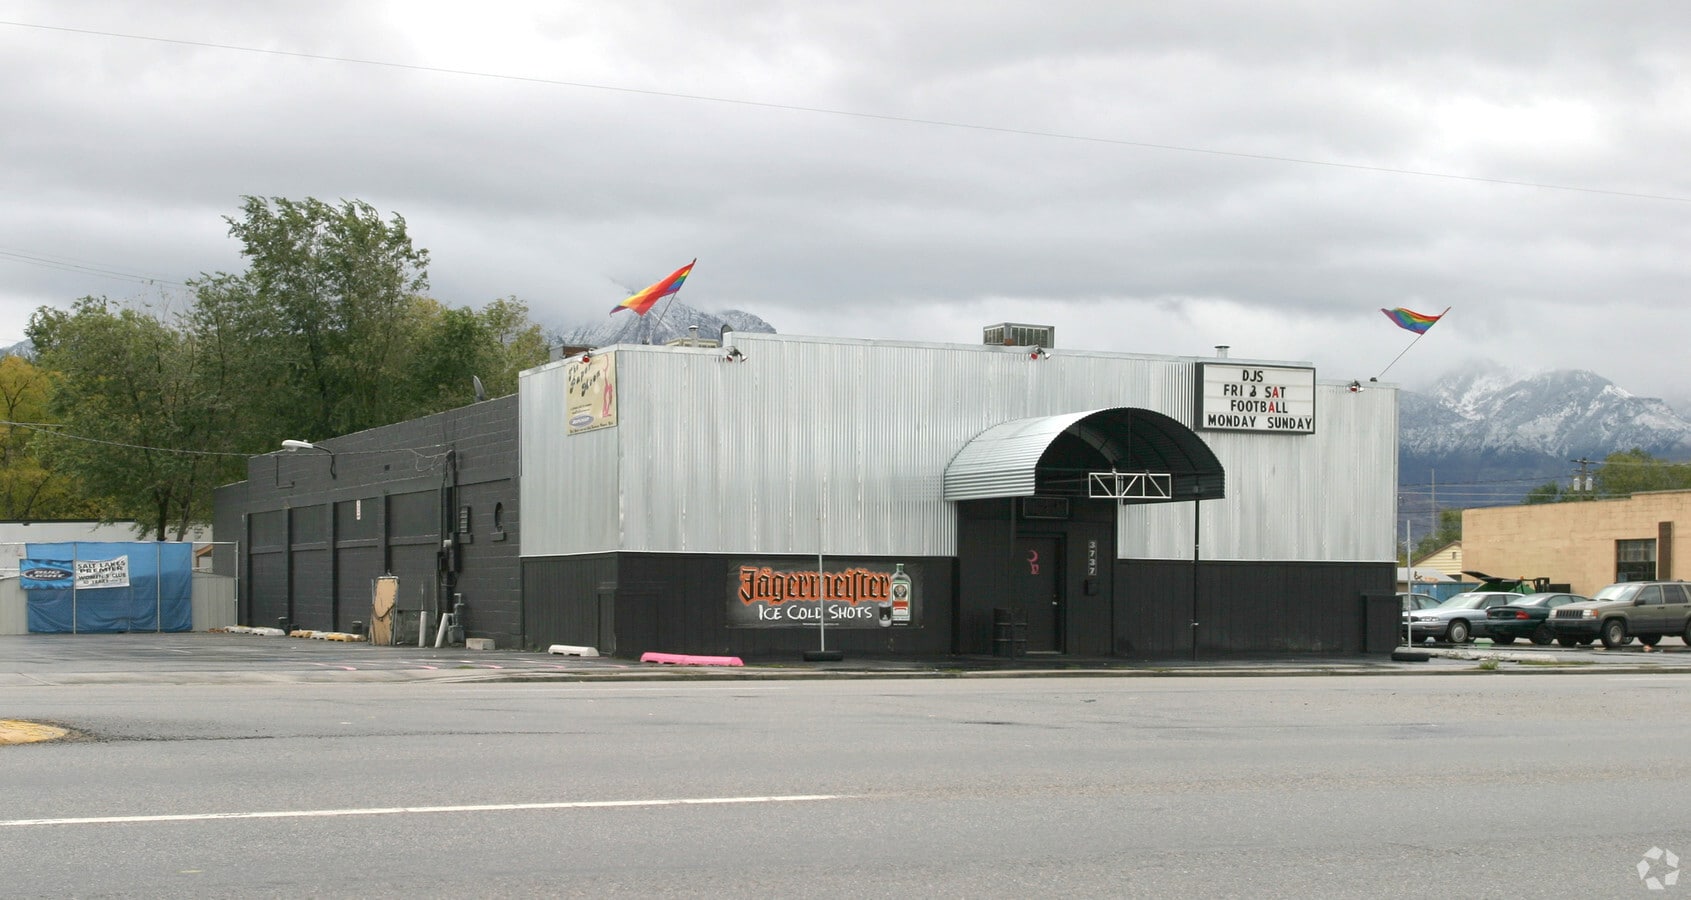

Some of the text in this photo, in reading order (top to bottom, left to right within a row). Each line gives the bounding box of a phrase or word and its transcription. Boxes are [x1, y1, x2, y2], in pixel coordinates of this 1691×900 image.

[1242, 370, 1263, 382] DJS
[1224, 384, 1243, 396] FRI
[1265, 386, 1286, 398] SAT
[1231, 400, 1288, 413] FOOTBALL
[1208, 414, 1312, 430] MONDAY SUNDAY
[1088, 541, 1097, 575] 3737
